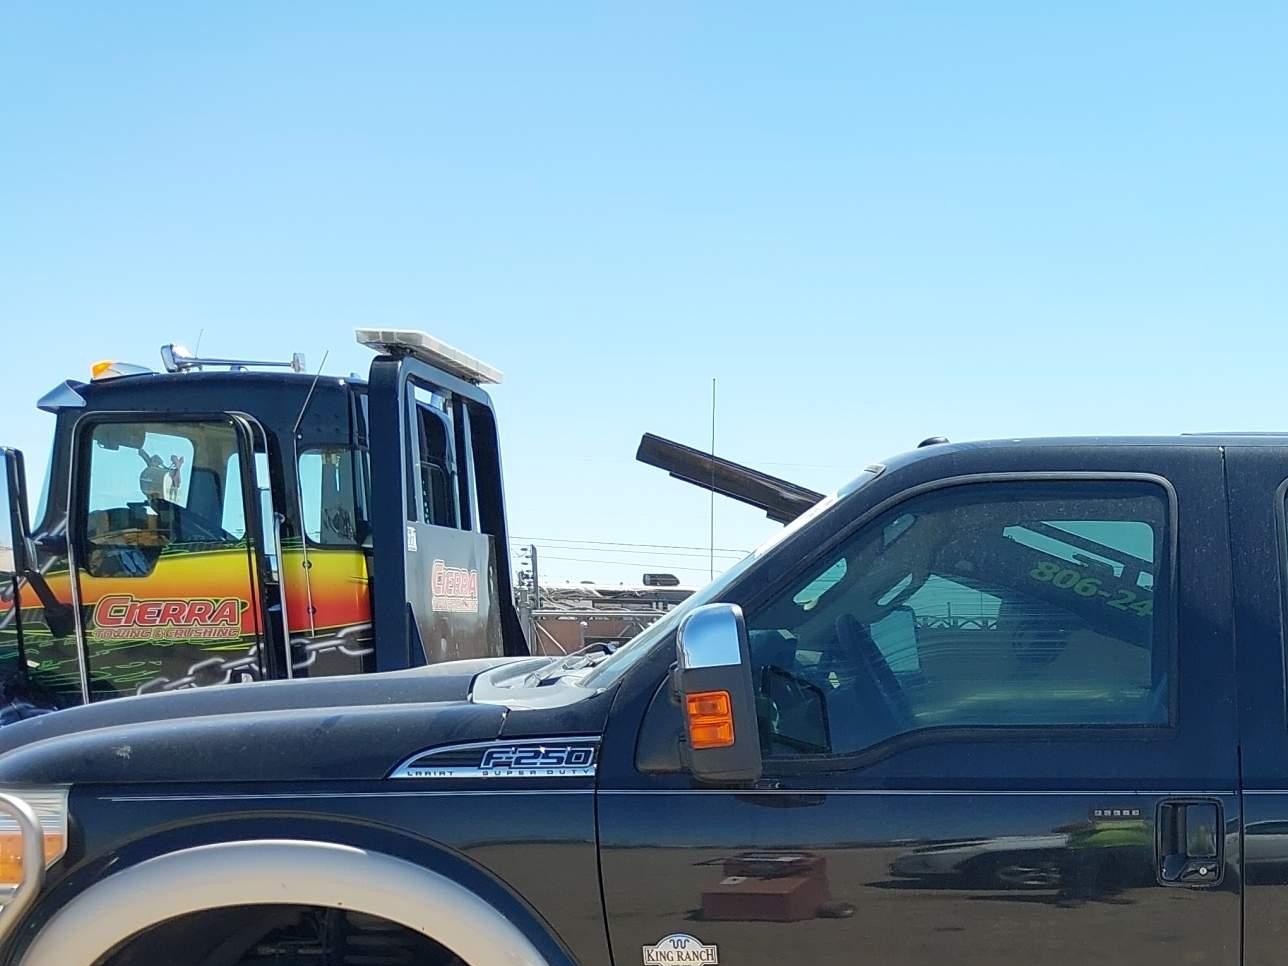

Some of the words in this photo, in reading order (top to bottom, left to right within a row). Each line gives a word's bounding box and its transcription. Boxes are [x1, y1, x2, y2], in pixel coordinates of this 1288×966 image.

[95, 596, 239, 627] CIERRA
[95, 628, 150, 639] TOWING
[152, 628, 163, 639] &
[165, 628, 239, 639] CRUSHING
[482, 769, 536, 777] SUPER
[546, 768, 590, 776] DUTY
[646, 948, 674, 962] KING
[677, 948, 714, 962] RANCH
